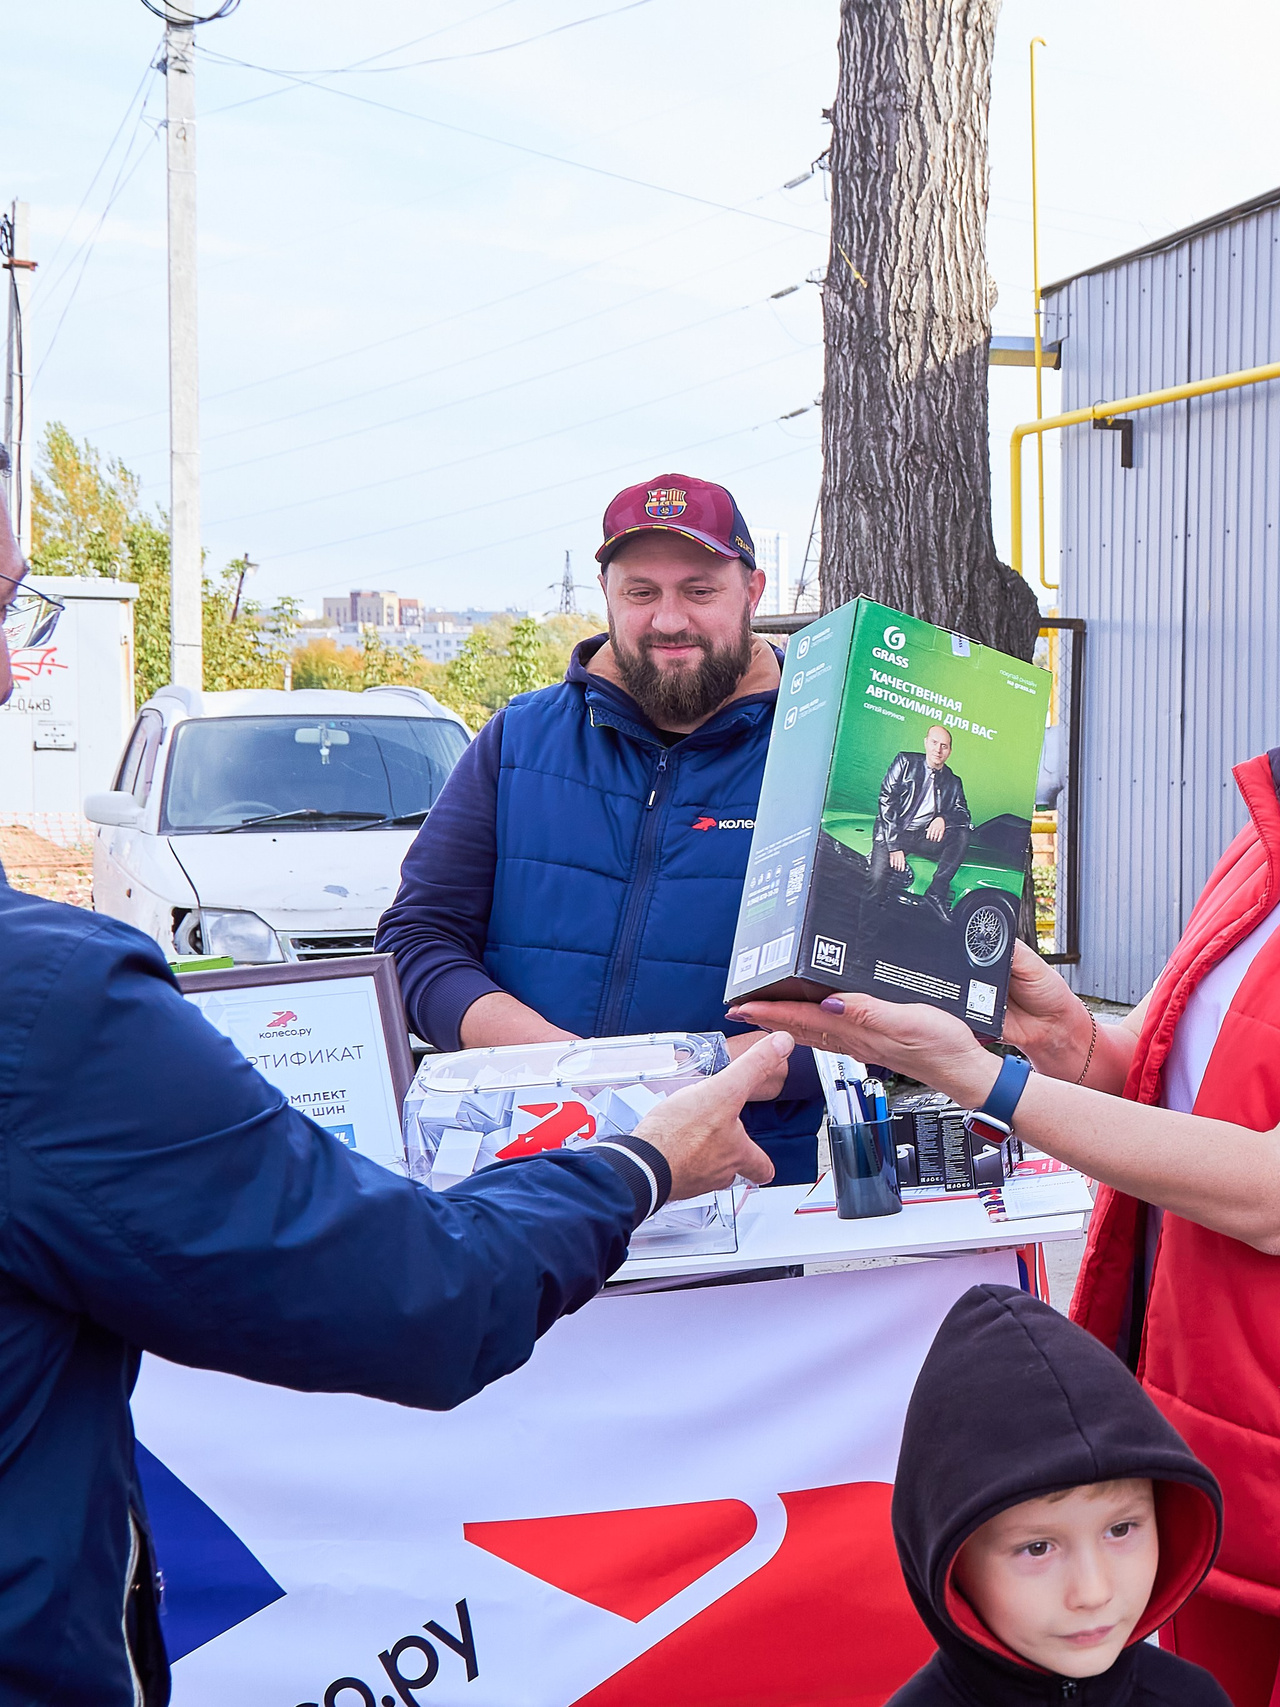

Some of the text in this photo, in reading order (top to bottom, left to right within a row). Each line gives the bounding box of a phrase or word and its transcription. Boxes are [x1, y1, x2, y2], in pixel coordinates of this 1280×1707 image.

[872, 647, 909, 669] GRASS
[865, 684, 943, 722] АВТОХИМИЯ
[943, 713, 970, 732] ДЛЯ
[718, 819, 756, 830] коле
[258, 1028, 312, 1039] колесо.ру
[312, 1105, 346, 1117] ШИН
